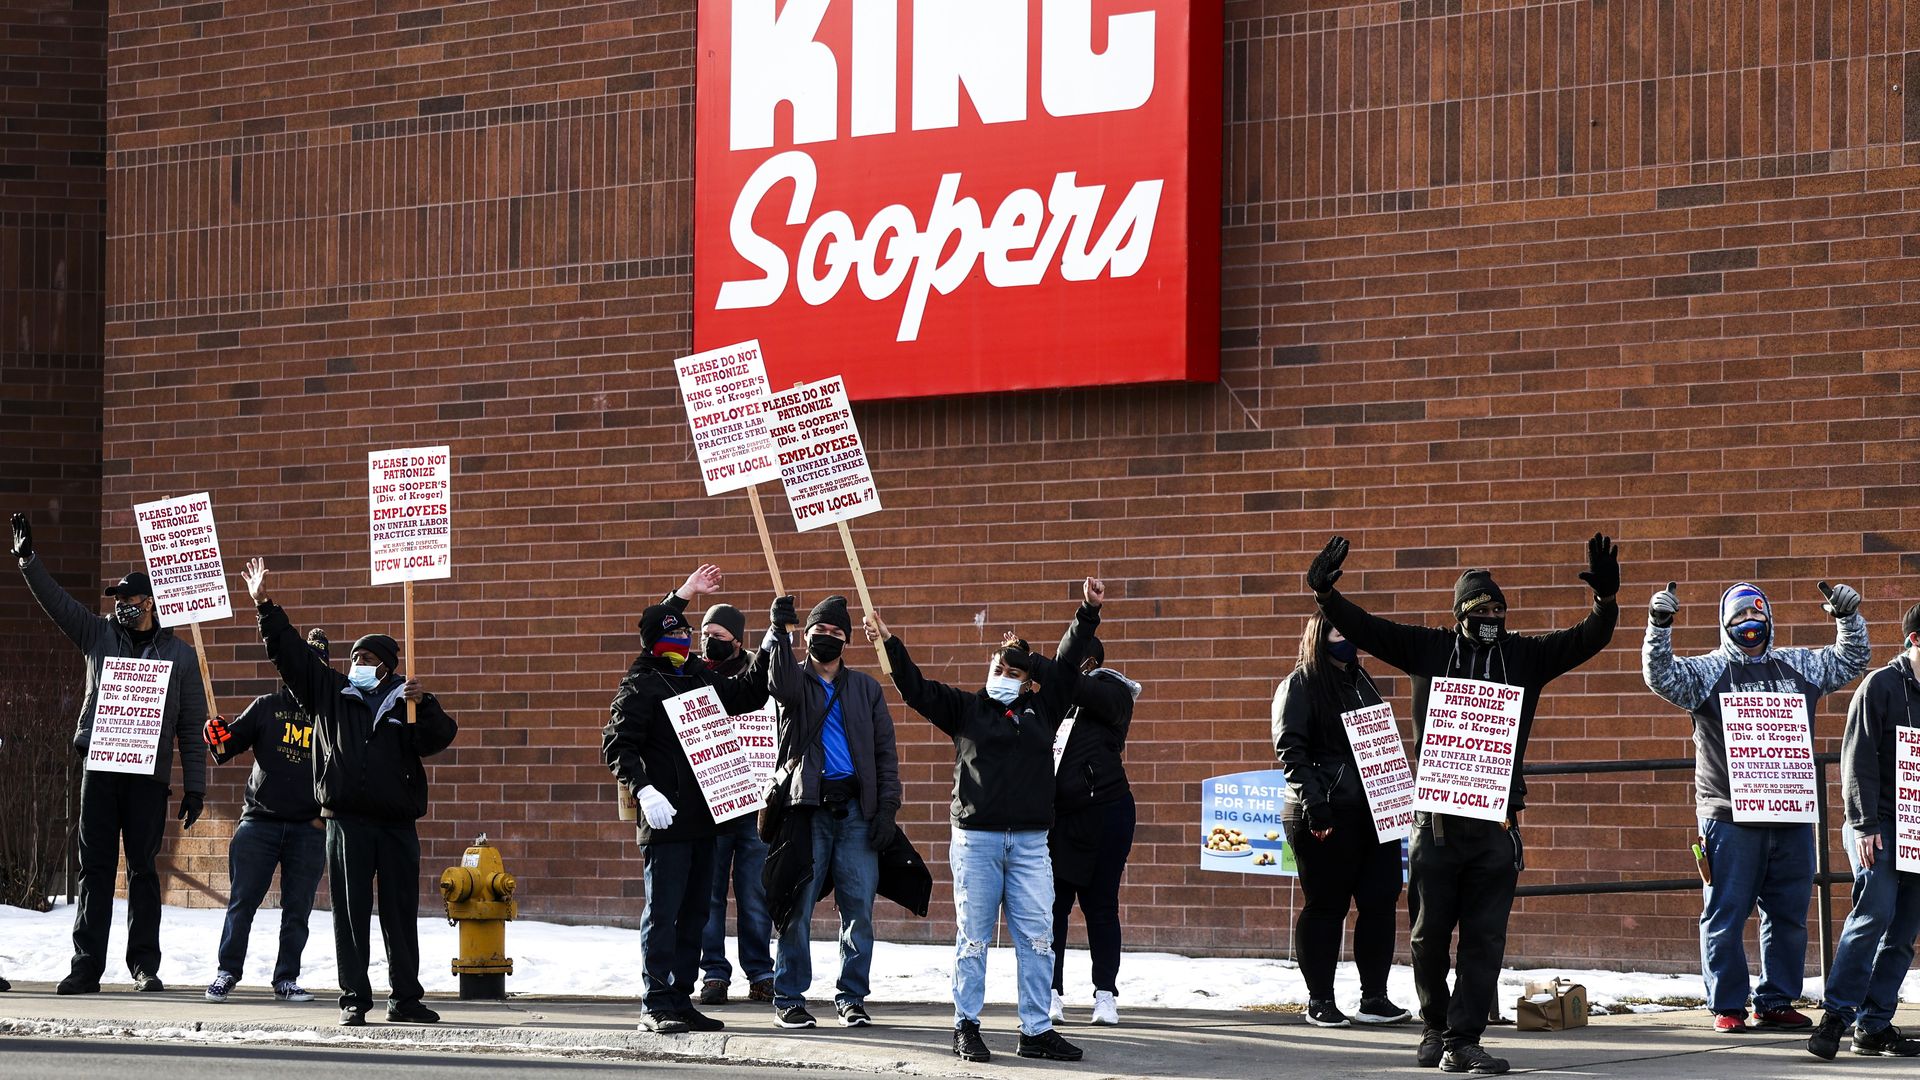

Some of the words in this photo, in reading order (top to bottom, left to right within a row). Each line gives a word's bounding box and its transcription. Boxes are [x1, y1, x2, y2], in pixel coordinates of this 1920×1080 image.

[715, 151, 1164, 341] Soopers
[680, 359, 719, 377] PLEASE
[720, 355, 735, 367] DO
[738, 349, 757, 363] NOT
[695, 364, 749, 386] PATRONIZE
[686, 389, 712, 402] KING
[714, 376, 765, 395] SOOPER'S
[728, 387, 763, 402] Kroger)
[762, 393, 801, 413] PLEASE
[802, 389, 818, 401] DO
[820, 382, 840, 396] NOT
[777, 397, 833, 421] PATRONIZE
[770, 424, 796, 438] KING
[798, 409, 849, 430] SOOPER'S
[778, 436, 799, 448] (Div.
[801, 430, 810, 440] of
[812, 420, 848, 437] Kroger)
[778, 434, 858, 466] EMPLOYEES
[372, 457, 408, 470] PLEASE
[411, 456, 424, 466] DO
[427, 455, 446, 465] NOT
[706, 464, 735, 481] UFCW
[737, 456, 771, 474] LOCAL
[782, 467, 796, 477] ON
[797, 457, 831, 472] UNFAIR
[831, 449, 863, 463] LABOR
[384, 467, 434, 480] PATRONIZE
[786, 468, 832, 487] PRACTICE
[832, 458, 865, 474] STRIKE
[372, 484, 396, 494] KING
[399, 480, 446, 491] SOOPER'S
[376, 494, 395, 504] (Div.
[399, 493, 406, 501] of
[410, 490, 442, 500] Kroger)
[795, 501, 824, 520] UFCW
[826, 492, 862, 511] LOCAL
[864, 488, 873, 500] #7
[139, 507, 173, 522] PLEASE
[174, 505, 187, 515] DO
[189, 502, 206, 513] NOT
[373, 504, 446, 520] EMPLOYEES
[151, 514, 199, 530] PATRONIZE
[373, 523, 385, 531] ON
[387, 520, 418, 530] UNFAIR
[420, 517, 448, 527] LABOR
[144, 533, 166, 544] KING
[168, 526, 212, 539] SOOPER'S
[374, 529, 416, 540] PRACTICE
[418, 526, 447, 536] STRIKE
[150, 543, 168, 553] (Div.
[179, 535, 210, 546] Kroger)
[149, 548, 217, 568] EMPLOYEES
[374, 558, 401, 571] UFCW
[404, 555, 434, 568] LOCAL
[438, 554, 447, 565] #7
[151, 570, 163, 578] ON
[164, 565, 193, 576] UNFAIR
[194, 560, 221, 571] LABOR
[154, 574, 193, 587] PRACTICE
[194, 569, 222, 580] STRIKE
[159, 602, 184, 615] UFCW
[186, 597, 216, 611] LOCAL
[218, 595, 226, 605] #7
[105, 661, 136, 671] PLEASE
[138, 663, 150, 672] DO
[152, 664, 169, 674] NOT
[113, 672, 157, 683] PATRONIZE
[124, 685, 165, 695] SOOPER'S
[1434, 681, 1476, 695] PLEASE
[1478, 686, 1494, 697] DO
[1498, 689, 1520, 700] NOT
[132, 694, 160, 704] Kroger)
[683, 700, 695, 712] DO
[696, 695, 711, 707] NOT
[1445, 694, 1505, 711] PATRONIZE
[1725, 697, 1764, 707] PLEASE
[1766, 698, 1781, 707] DO
[1784, 698, 1804, 708] NOT
[98, 705, 161, 718] EMPLOYEES
[680, 704, 720, 724] PATRONIZE
[1429, 708, 1457, 719] KING
[1461, 712, 1516, 726] SOOPER'S
[1738, 708, 1793, 719] PATRONIZE
[95, 726, 132, 734] PRACTICE
[132, 728, 159, 736] STRIKE
[136, 720, 160, 728] LABOR
[1357, 720, 1390, 736] PATRONIZE
[1433, 719, 1454, 729] (Div.
[1459, 722, 1468, 730] of
[1471, 723, 1510, 737] Kroger)
[1727, 723, 1753, 731] KING
[1756, 723, 1807, 732] SOOPER'S
[282, 722, 313, 748] M
[1426, 733, 1512, 754] EMPLOYEES
[1732, 732, 1753, 741] (Div.
[1768, 733, 1804, 743] Kroger)
[91, 750, 114, 761] UFCW
[116, 752, 142, 764] LOCAL
[145, 754, 154, 764] #7
[690, 739, 740, 766] EMPLOYEES
[1424, 748, 1438, 757] ON
[1441, 750, 1476, 761] UNFAIR
[1478, 754, 1512, 766] LABOR
[1730, 747, 1810, 759] EMPLOYEES
[1361, 758, 1407, 778] EMPLOYEES
[1423, 758, 1472, 771] PRACTICE
[1474, 764, 1510, 776] STRIKE
[1215, 784, 1238, 795] BIG
[1215, 797, 1244, 809] FOR
[1249, 799, 1274, 810] THE
[1418, 787, 1450, 802] UFCW
[1453, 792, 1489, 808] LOCAL
[1493, 798, 1505, 810] #7
[1735, 799, 1765, 811] UFCW
[1768, 800, 1802, 812] LOCAL
[1806, 801, 1815, 812] #7
[712, 802, 735, 816] UFCW
[1215, 810, 1238, 821] BIG
[1243, 812, 1282, 824] GAME
